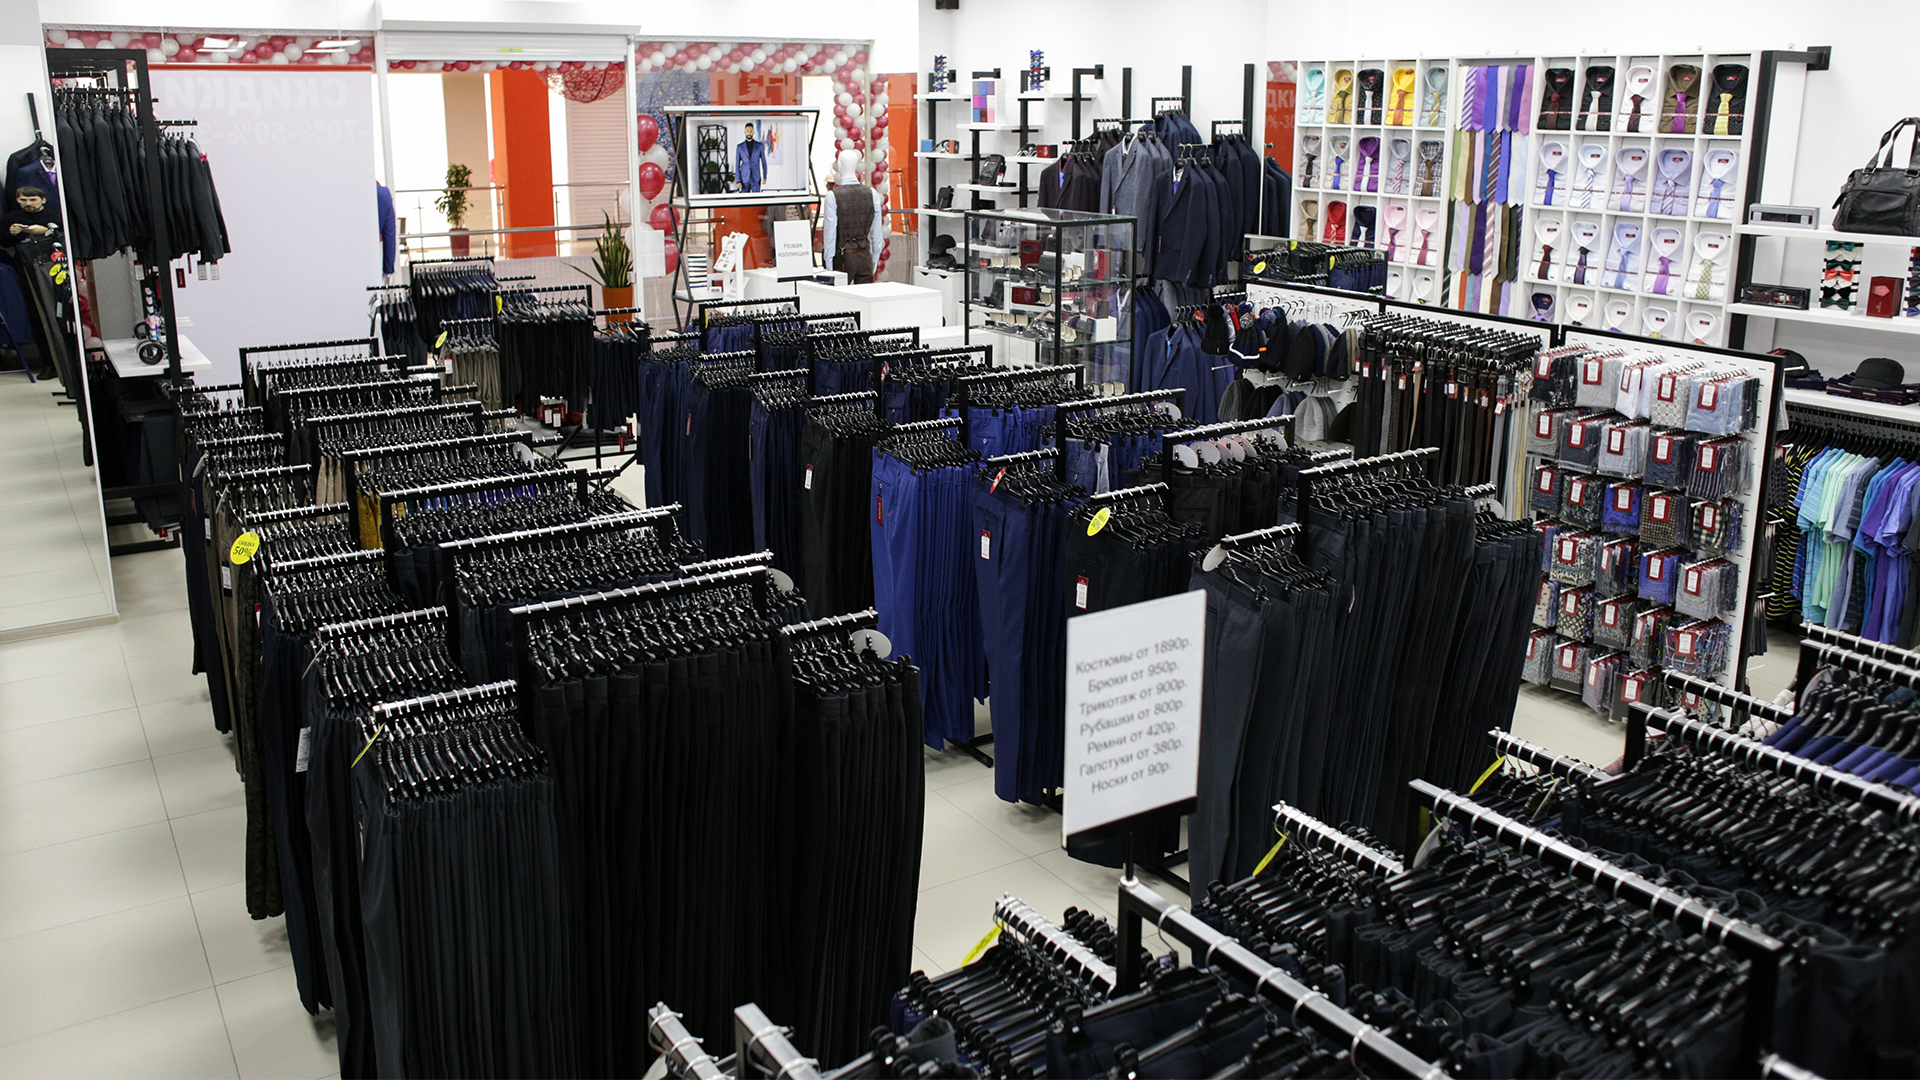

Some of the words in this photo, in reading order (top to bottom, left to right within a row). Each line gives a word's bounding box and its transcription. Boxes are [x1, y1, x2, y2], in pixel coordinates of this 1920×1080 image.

[233, 546, 252, 557] 50%
[1076, 652, 1133, 675] Костюмы
[1137, 646, 1149, 659] от
[1154, 636, 1191, 656] 1890р.
[1089, 673, 1127, 693] Брюки
[1131, 669, 1144, 681] от
[1148, 661, 1179, 677] 950р.
[1080, 693, 1137, 716] Трикотаж
[1140, 687, 1153, 700] от
[1156, 679, 1187, 696] 900р.
[1080, 714, 1134, 737] Рубашки
[1137, 708, 1151, 721] от
[1154, 699, 1185, 717] 800р.
[1088, 735, 1127, 755] Ремни
[1130, 729, 1143, 741] от
[1146, 720, 1178, 737] 420р.
[1080, 753, 1133, 777] Галстуки
[1137, 748, 1150, 761] от
[1153, 739, 1184, 756] 380р.
[1092, 772, 1128, 793] Носки
[1131, 768, 1144, 781] от
[1147, 760, 1172, 777] 90р.
